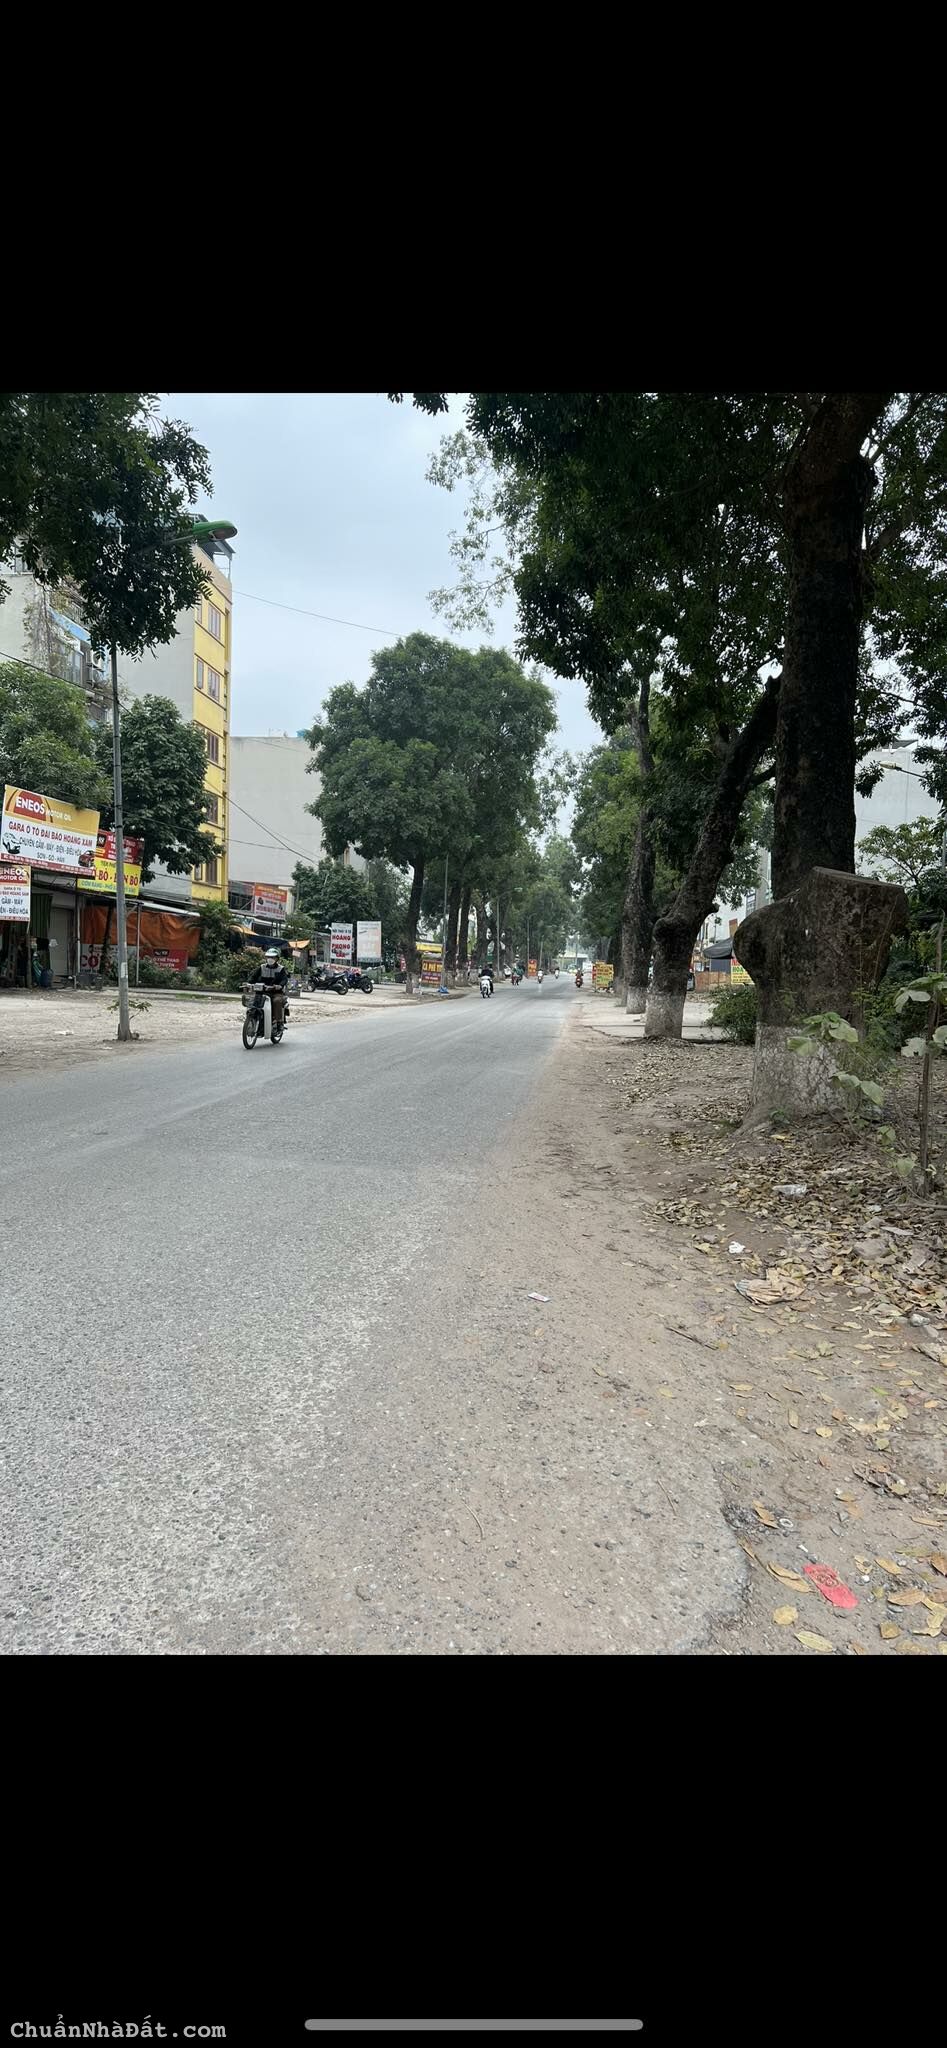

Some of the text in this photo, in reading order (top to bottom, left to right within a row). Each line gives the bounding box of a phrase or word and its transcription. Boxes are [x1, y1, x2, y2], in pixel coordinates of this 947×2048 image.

[15, 796, 72, 821] ENEOS MOTOR OIL
[8, 821, 25, 833] GARA
